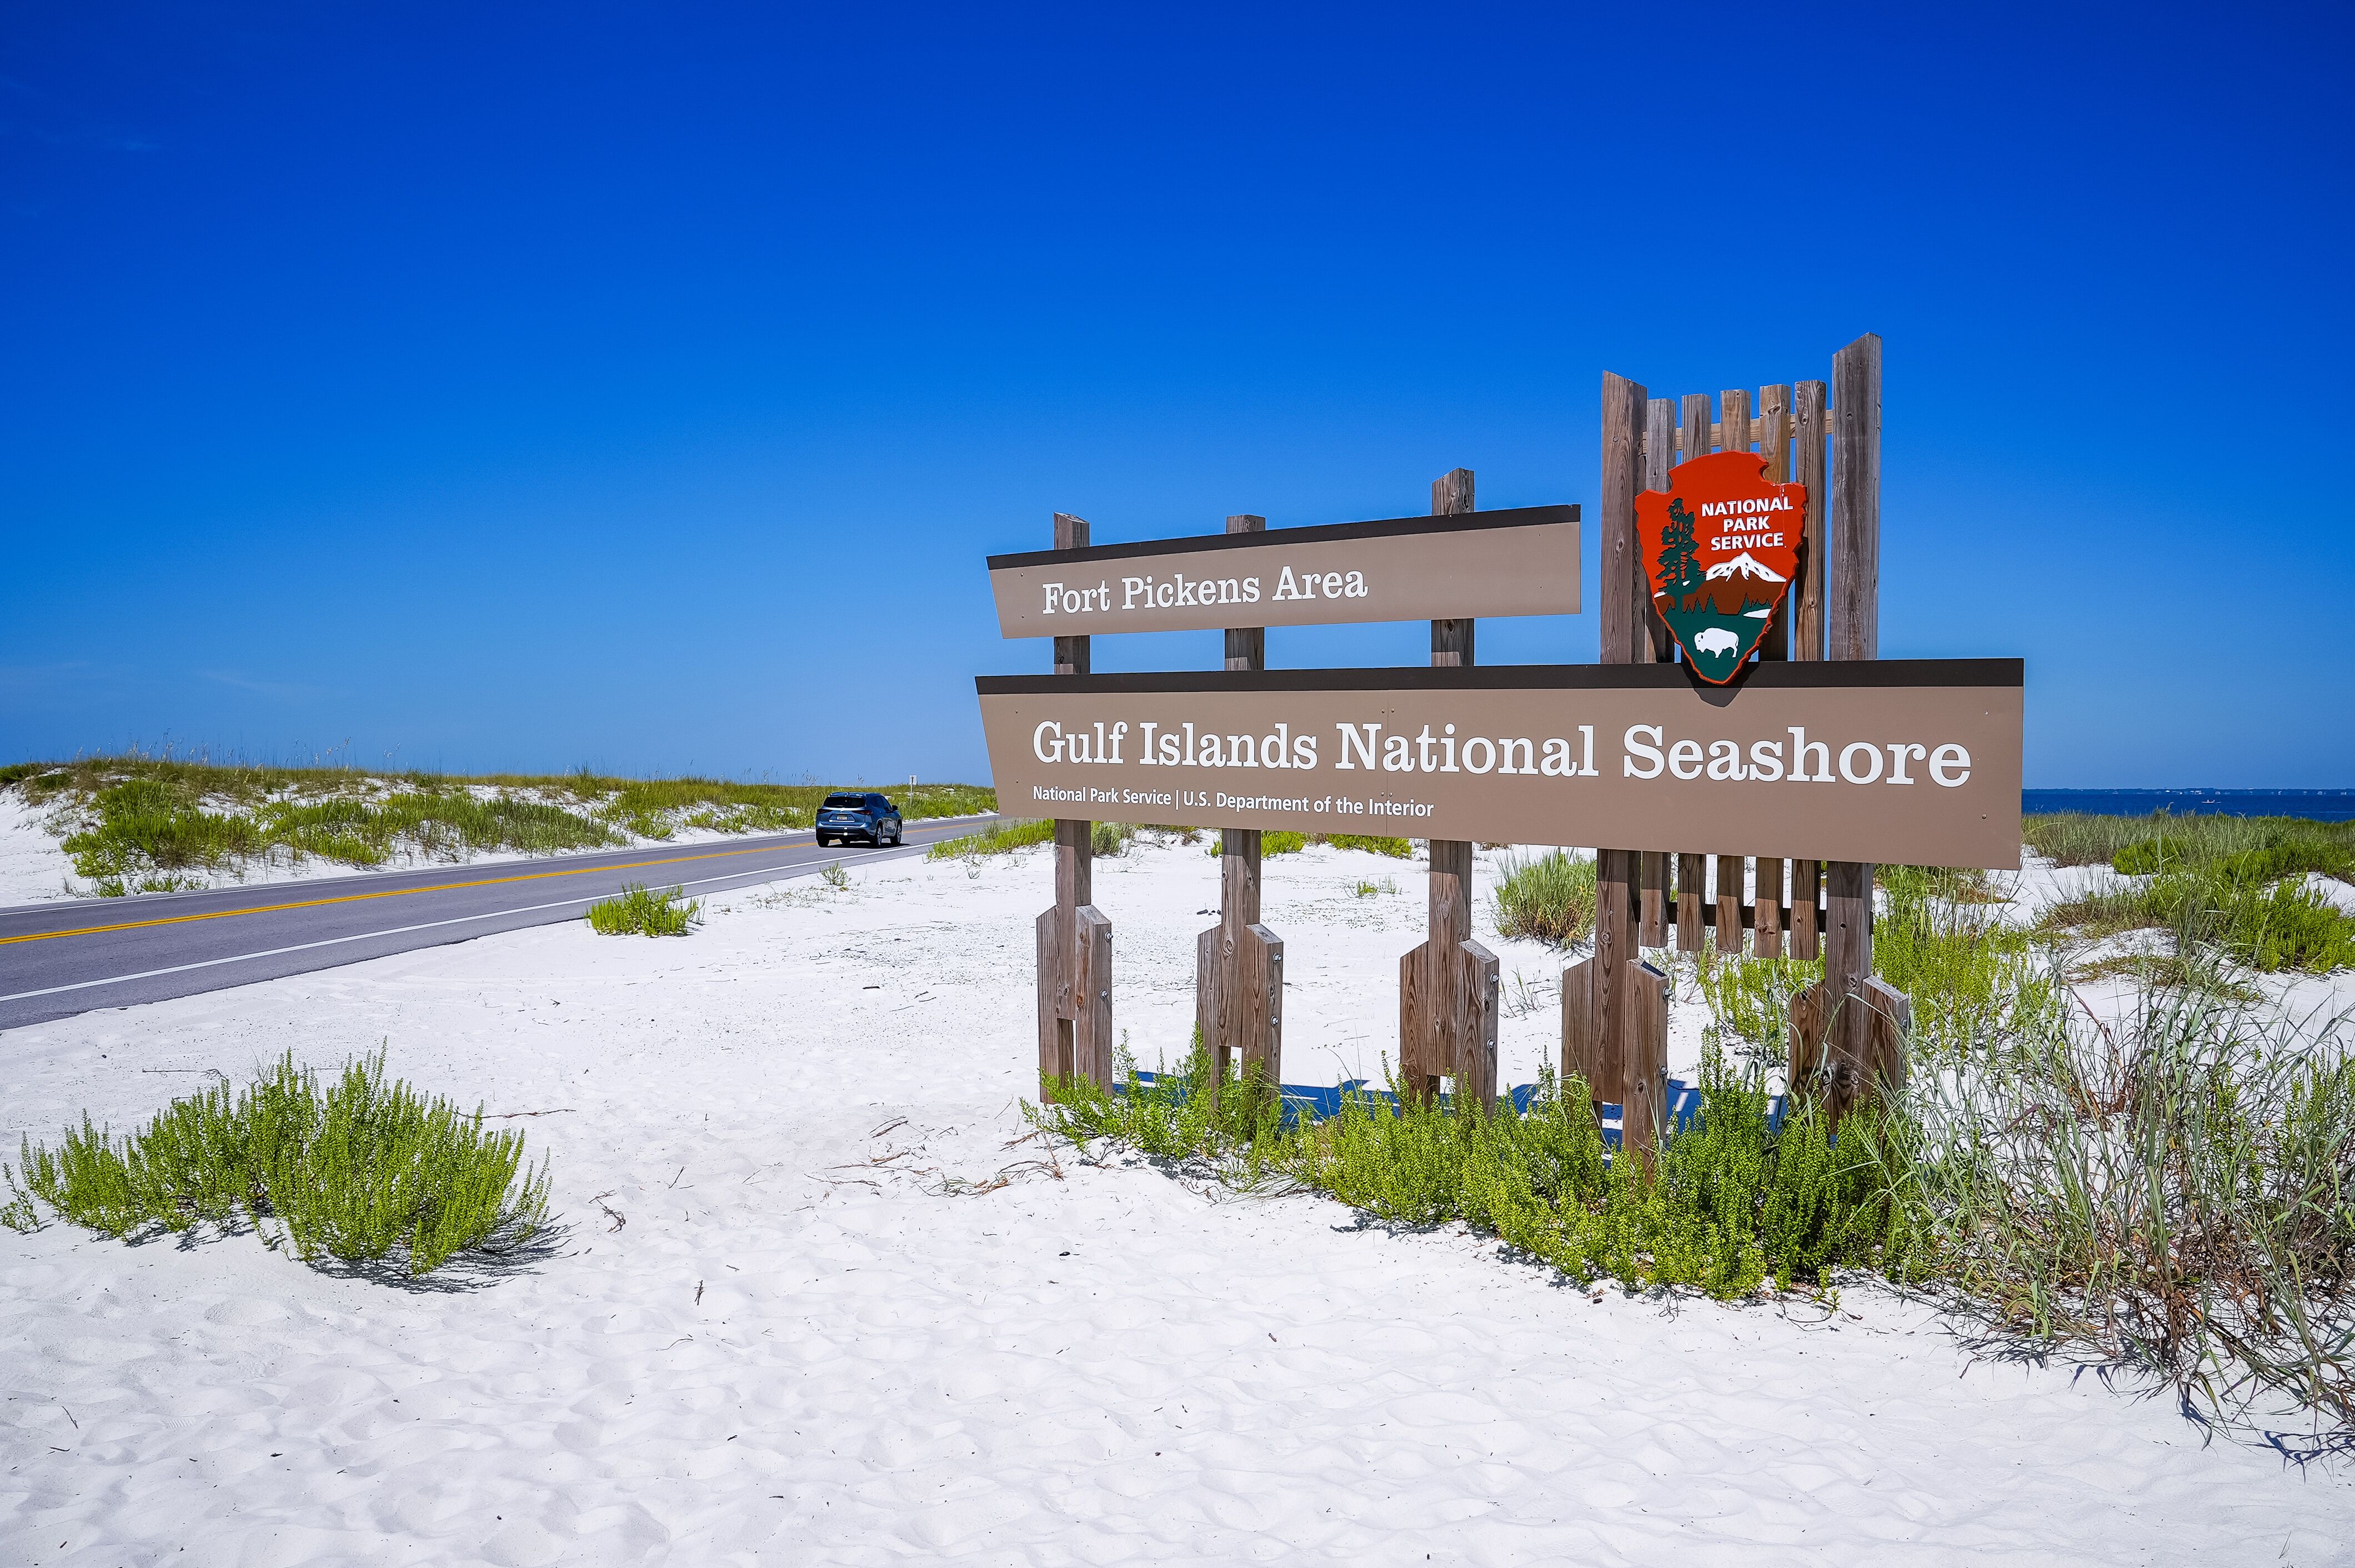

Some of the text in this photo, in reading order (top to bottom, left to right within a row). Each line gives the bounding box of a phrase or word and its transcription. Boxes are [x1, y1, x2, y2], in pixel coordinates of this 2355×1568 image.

[1701, 496, 1793, 517] NATIONAL
[1723, 515, 1770, 533] PARK
[1042, 565, 1369, 614] Fort Pickens Area
[1033, 720, 1971, 788] Gulf Islands National Seashore
[1033, 785, 1086, 802] National
[1090, 787, 1119, 803] Park
[1123, 789, 1171, 805] Service
[1184, 790, 1211, 807] U.S.
[1216, 792, 1309, 813] Department
[1314, 795, 1331, 813] of
[1335, 796, 1364, 814] the
[1369, 798, 1434, 817] Interior
